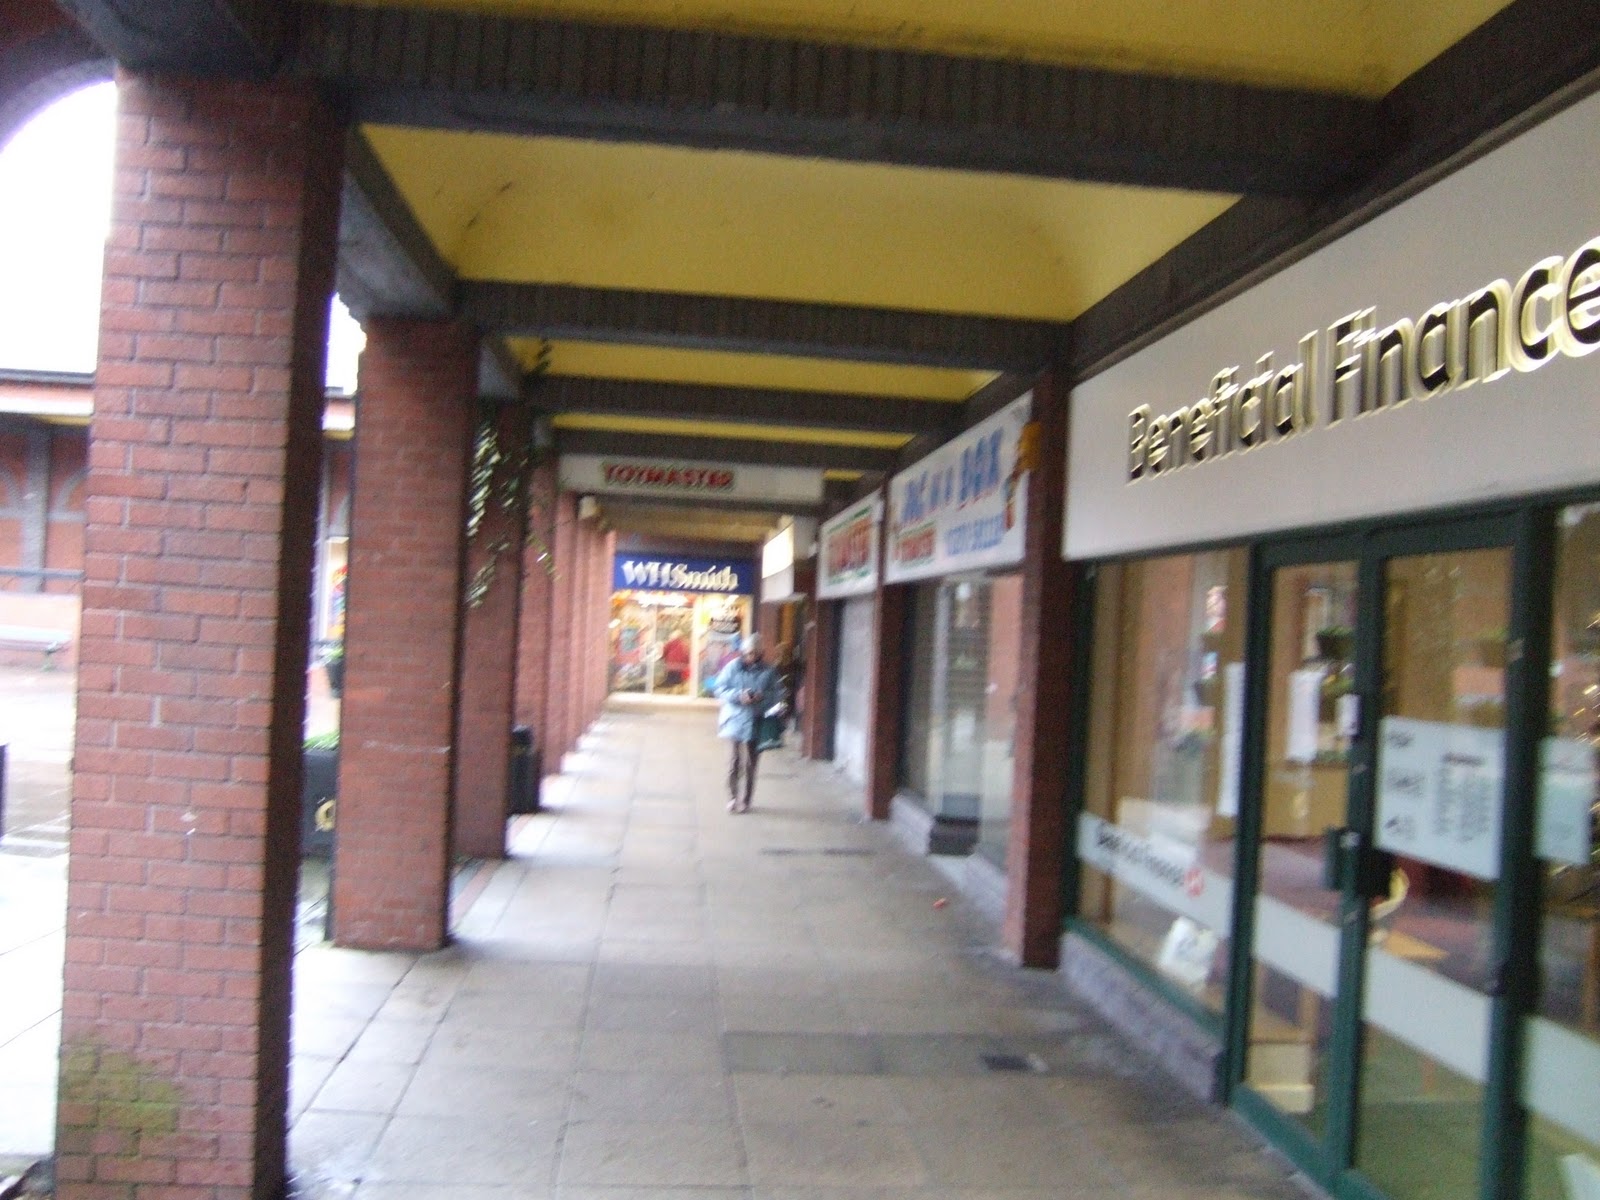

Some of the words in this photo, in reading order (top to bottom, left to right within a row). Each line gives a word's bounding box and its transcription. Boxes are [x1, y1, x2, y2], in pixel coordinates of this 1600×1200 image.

[1128, 329, 1318, 486] Beneficial
[1326, 235, 1600, 429] Finance
[603, 462, 733, 488] TOYMASTER
[621, 560, 739, 591] WHSmith
